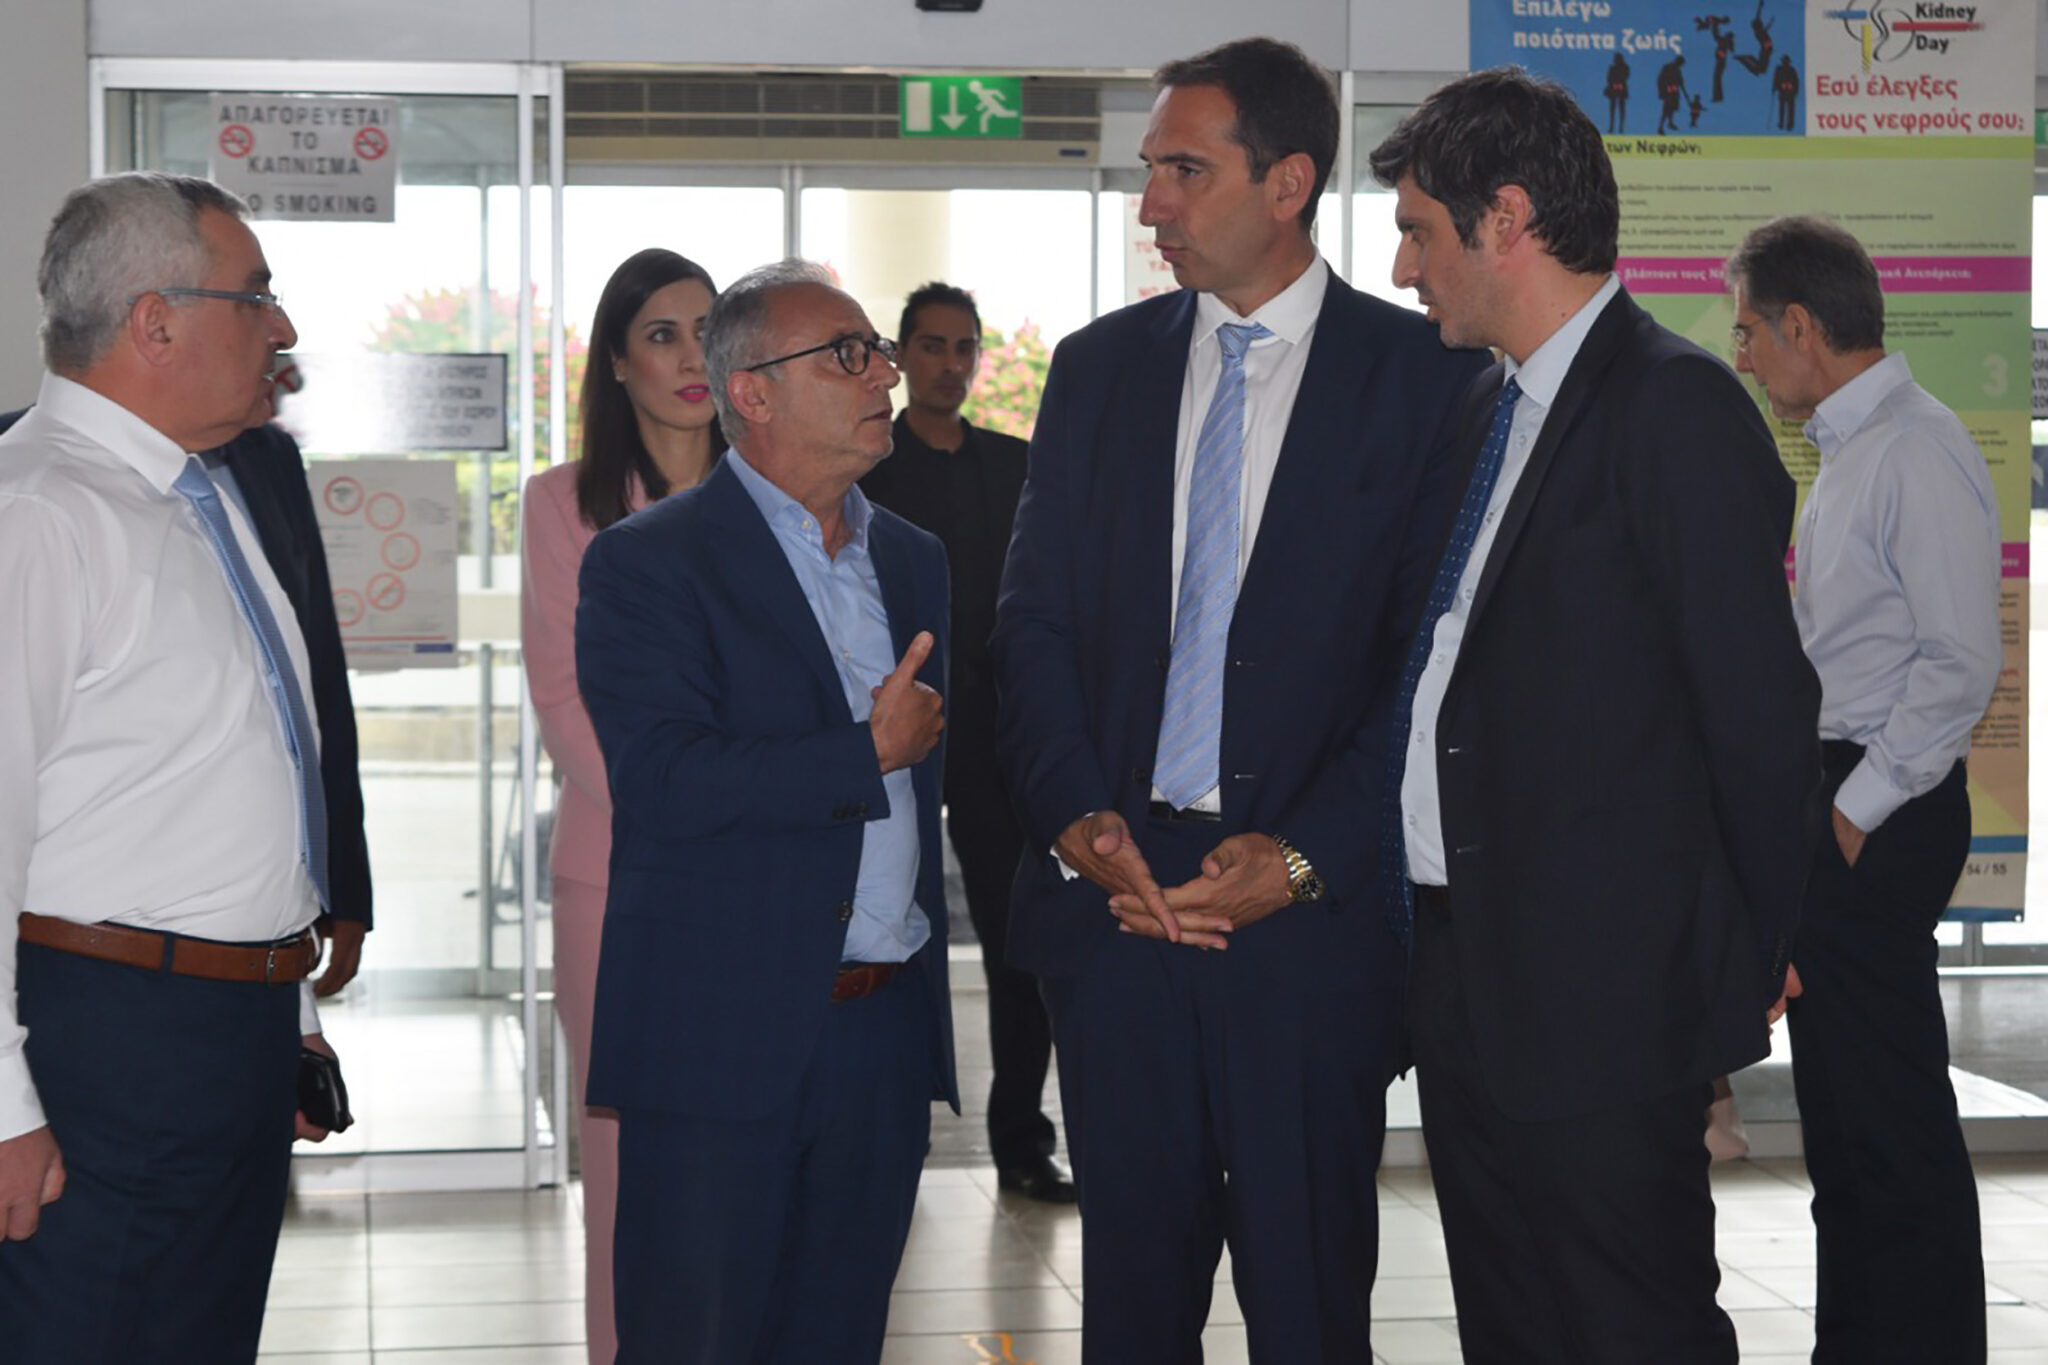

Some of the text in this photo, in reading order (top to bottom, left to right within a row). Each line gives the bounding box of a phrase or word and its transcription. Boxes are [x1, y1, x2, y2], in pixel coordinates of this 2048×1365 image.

[1916, 3, 1976, 21] Kidney
[1514, 26, 1682, 55] ποιότητα ζωής
[1916, 35, 1949, 53] Day
[1816, 74, 1958, 100] Εσύ έλεγξες
[218, 105, 390, 126] ΑΠΑΓΟΡΕΥΕΤΑΙ
[1816, 108, 2024, 133] τους νεφρούς σου;
[290, 131, 318, 150] ΤΟ
[247, 156, 362, 175] ΚΑΠΝΙΣΜΑ
[274, 195, 377, 214] SMOKING
[1981, 353, 2008, 398] 3
